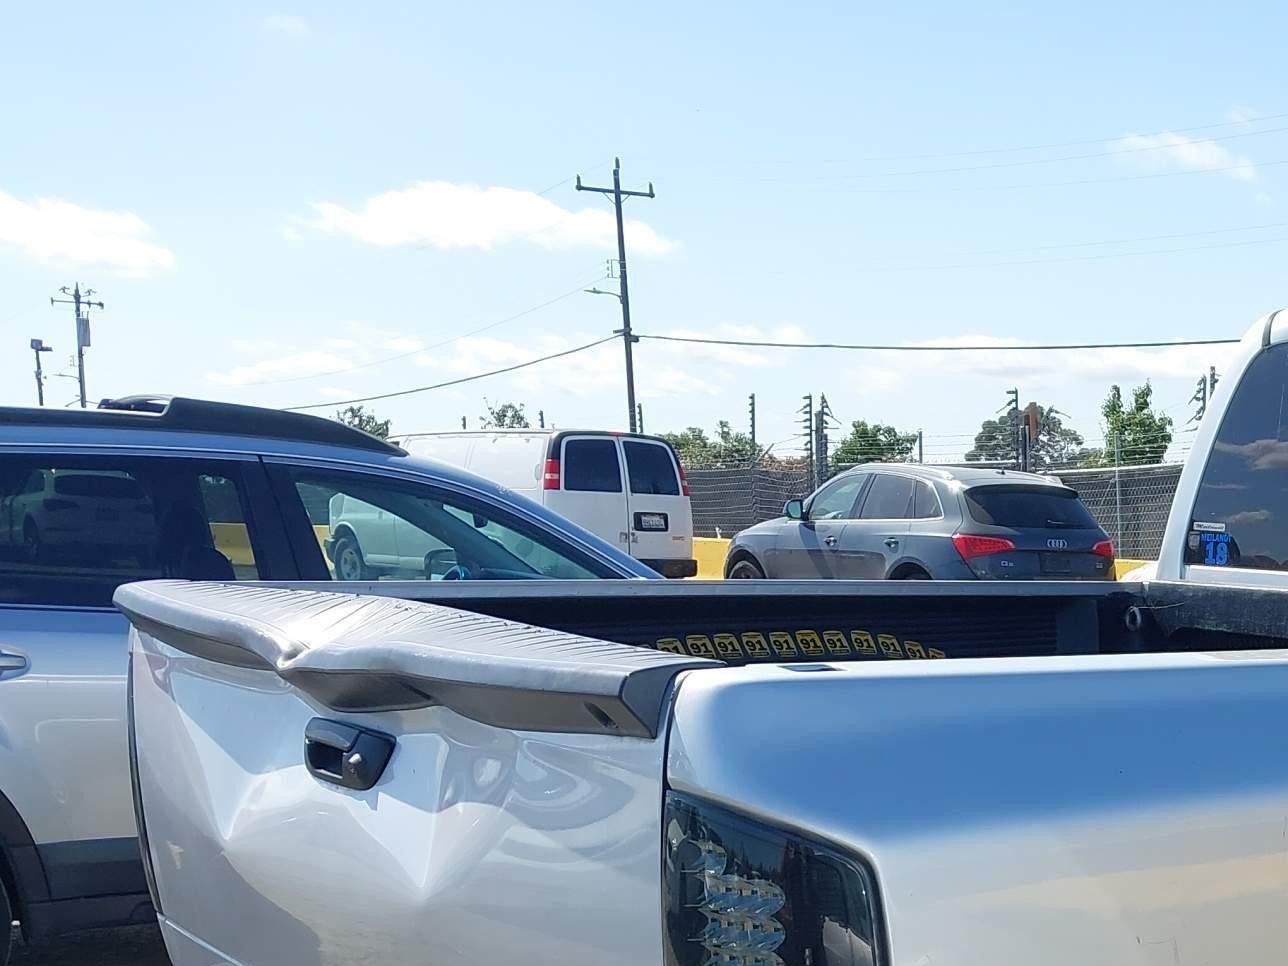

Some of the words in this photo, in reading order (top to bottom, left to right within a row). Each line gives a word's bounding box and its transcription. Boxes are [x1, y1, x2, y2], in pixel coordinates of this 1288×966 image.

[1205, 541, 1228, 565] 18
[690, 642, 713, 653] 91
[718, 641, 740, 652] 91
[745, 640, 767, 651] 91
[774, 639, 795, 650] 91
[800, 638, 820, 649] 91
[827, 638, 847, 649] 91
[855, 638, 874, 649] 91
[881, 640, 900, 652] 91
